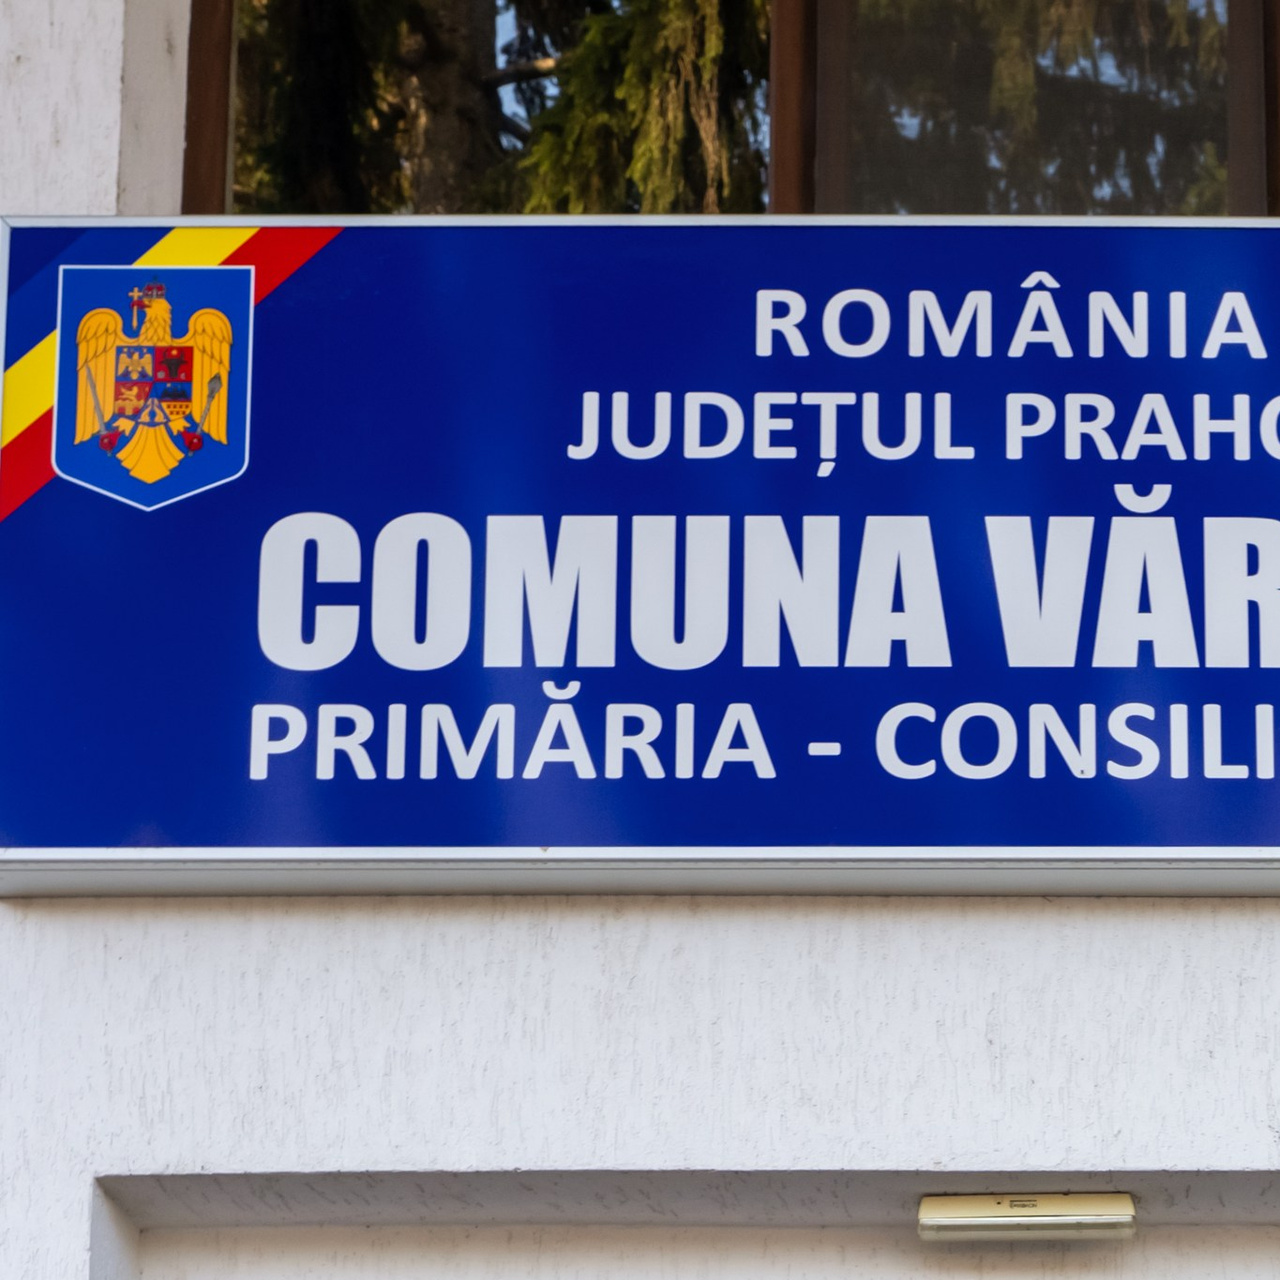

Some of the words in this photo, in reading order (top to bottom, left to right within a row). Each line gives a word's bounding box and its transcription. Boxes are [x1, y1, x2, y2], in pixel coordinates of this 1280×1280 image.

[757, 271, 1268, 359] ROMÂNIA
[258, 512, 952, 671] COMUNA
[249, 680, 776, 780] PRIMĂRIA
